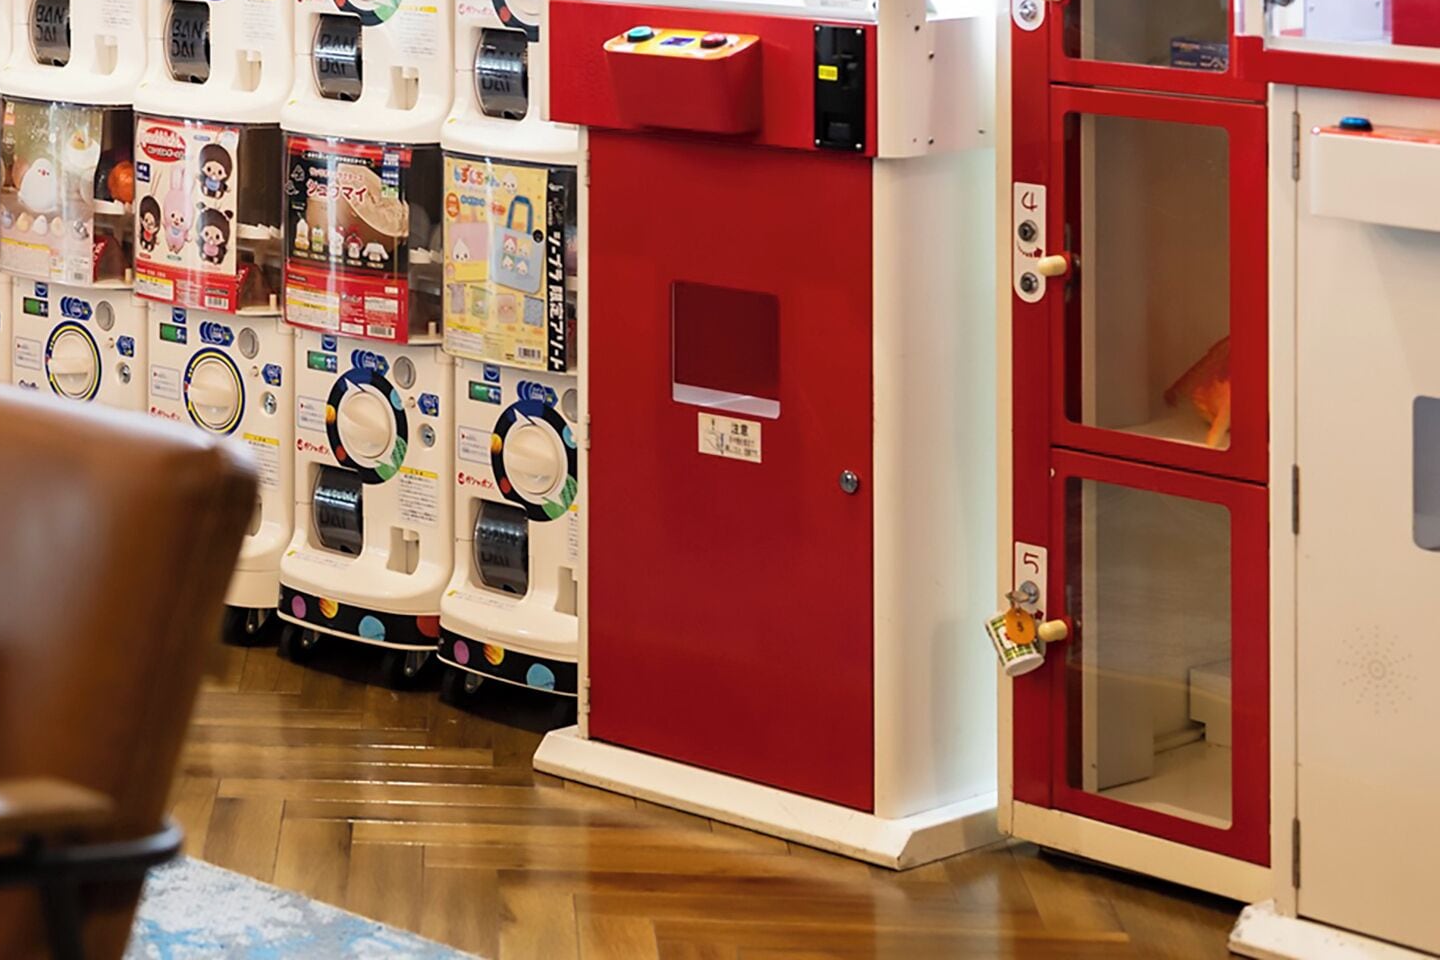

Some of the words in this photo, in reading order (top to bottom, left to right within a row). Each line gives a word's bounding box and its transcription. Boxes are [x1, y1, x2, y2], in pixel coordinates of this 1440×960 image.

[35, 4, 65, 24] BAN
[172, 18, 204, 39] BAN
[306, 178, 367, 202] シュウマイ
[1021, 190, 1039, 211] 4
[1023, 551, 1040, 575] 5
